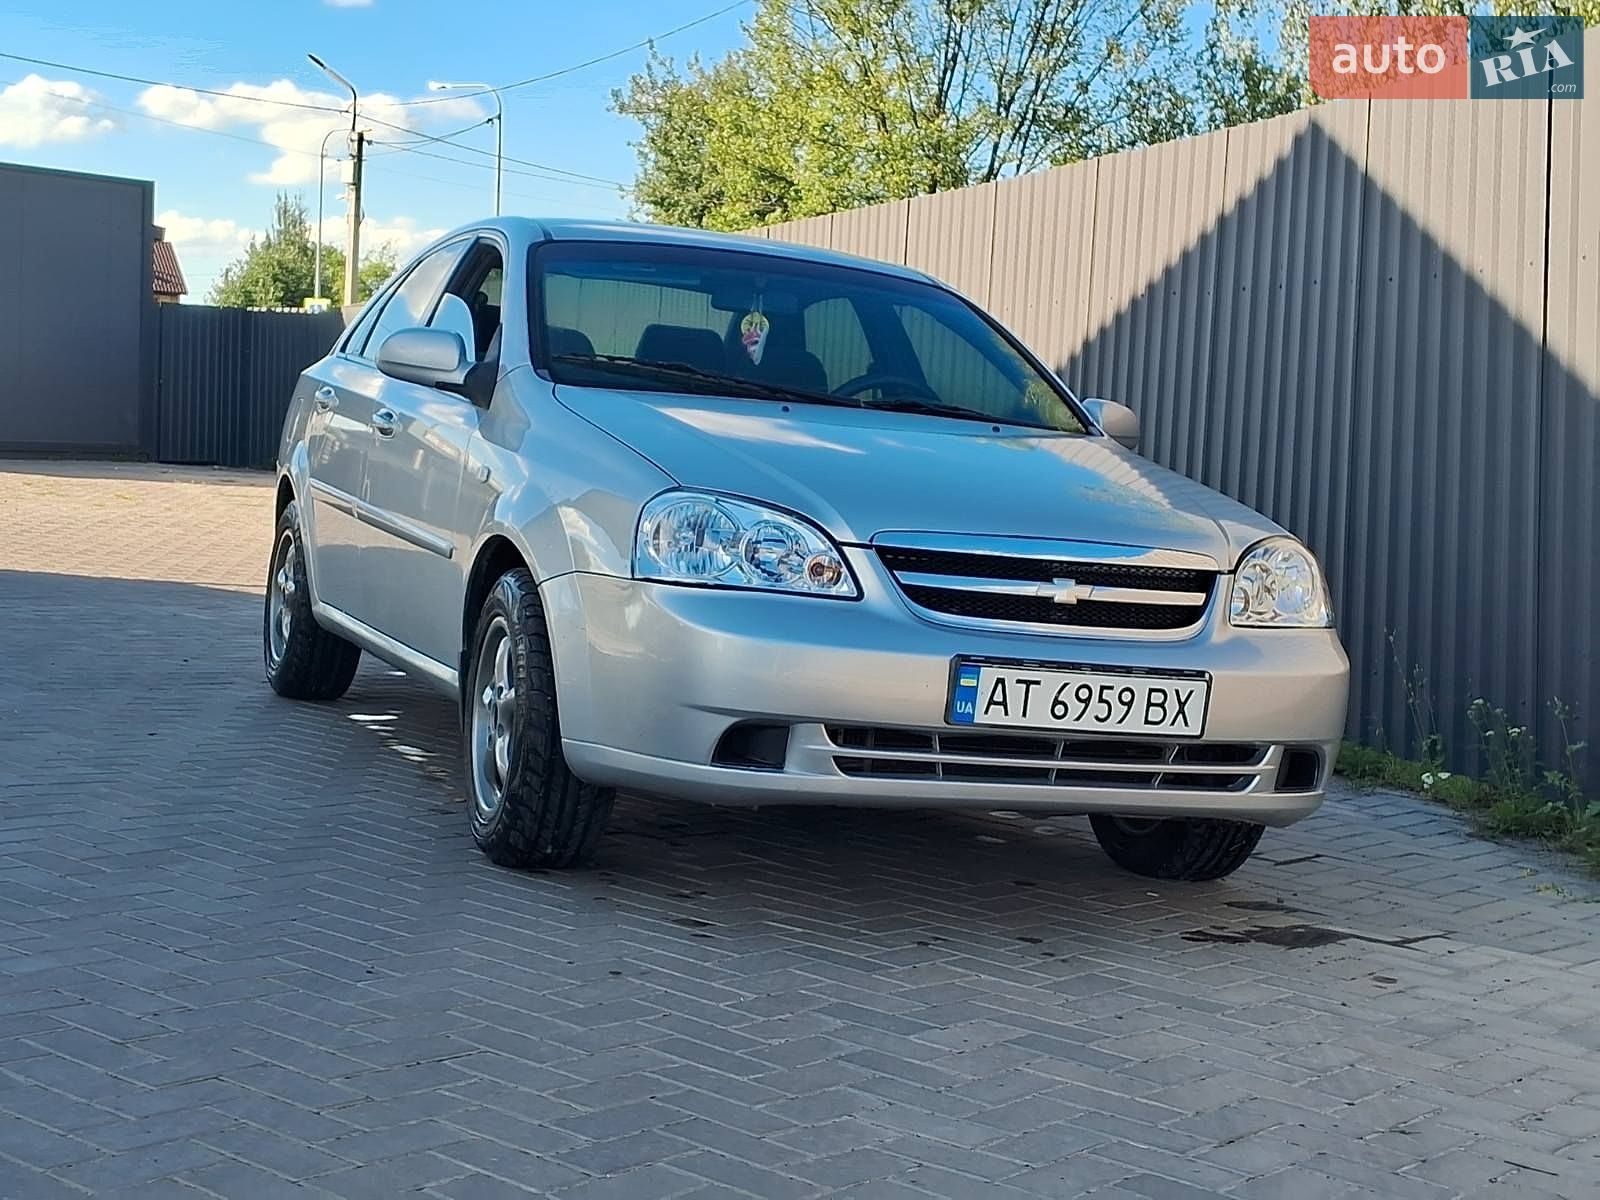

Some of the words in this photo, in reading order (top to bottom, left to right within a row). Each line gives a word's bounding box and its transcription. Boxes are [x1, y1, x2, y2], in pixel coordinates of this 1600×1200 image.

[956, 701, 973, 715] UA
[983, 677, 1041, 718] AT
[1050, 682, 1136, 724] 6959
[1143, 687, 1195, 727] BX
